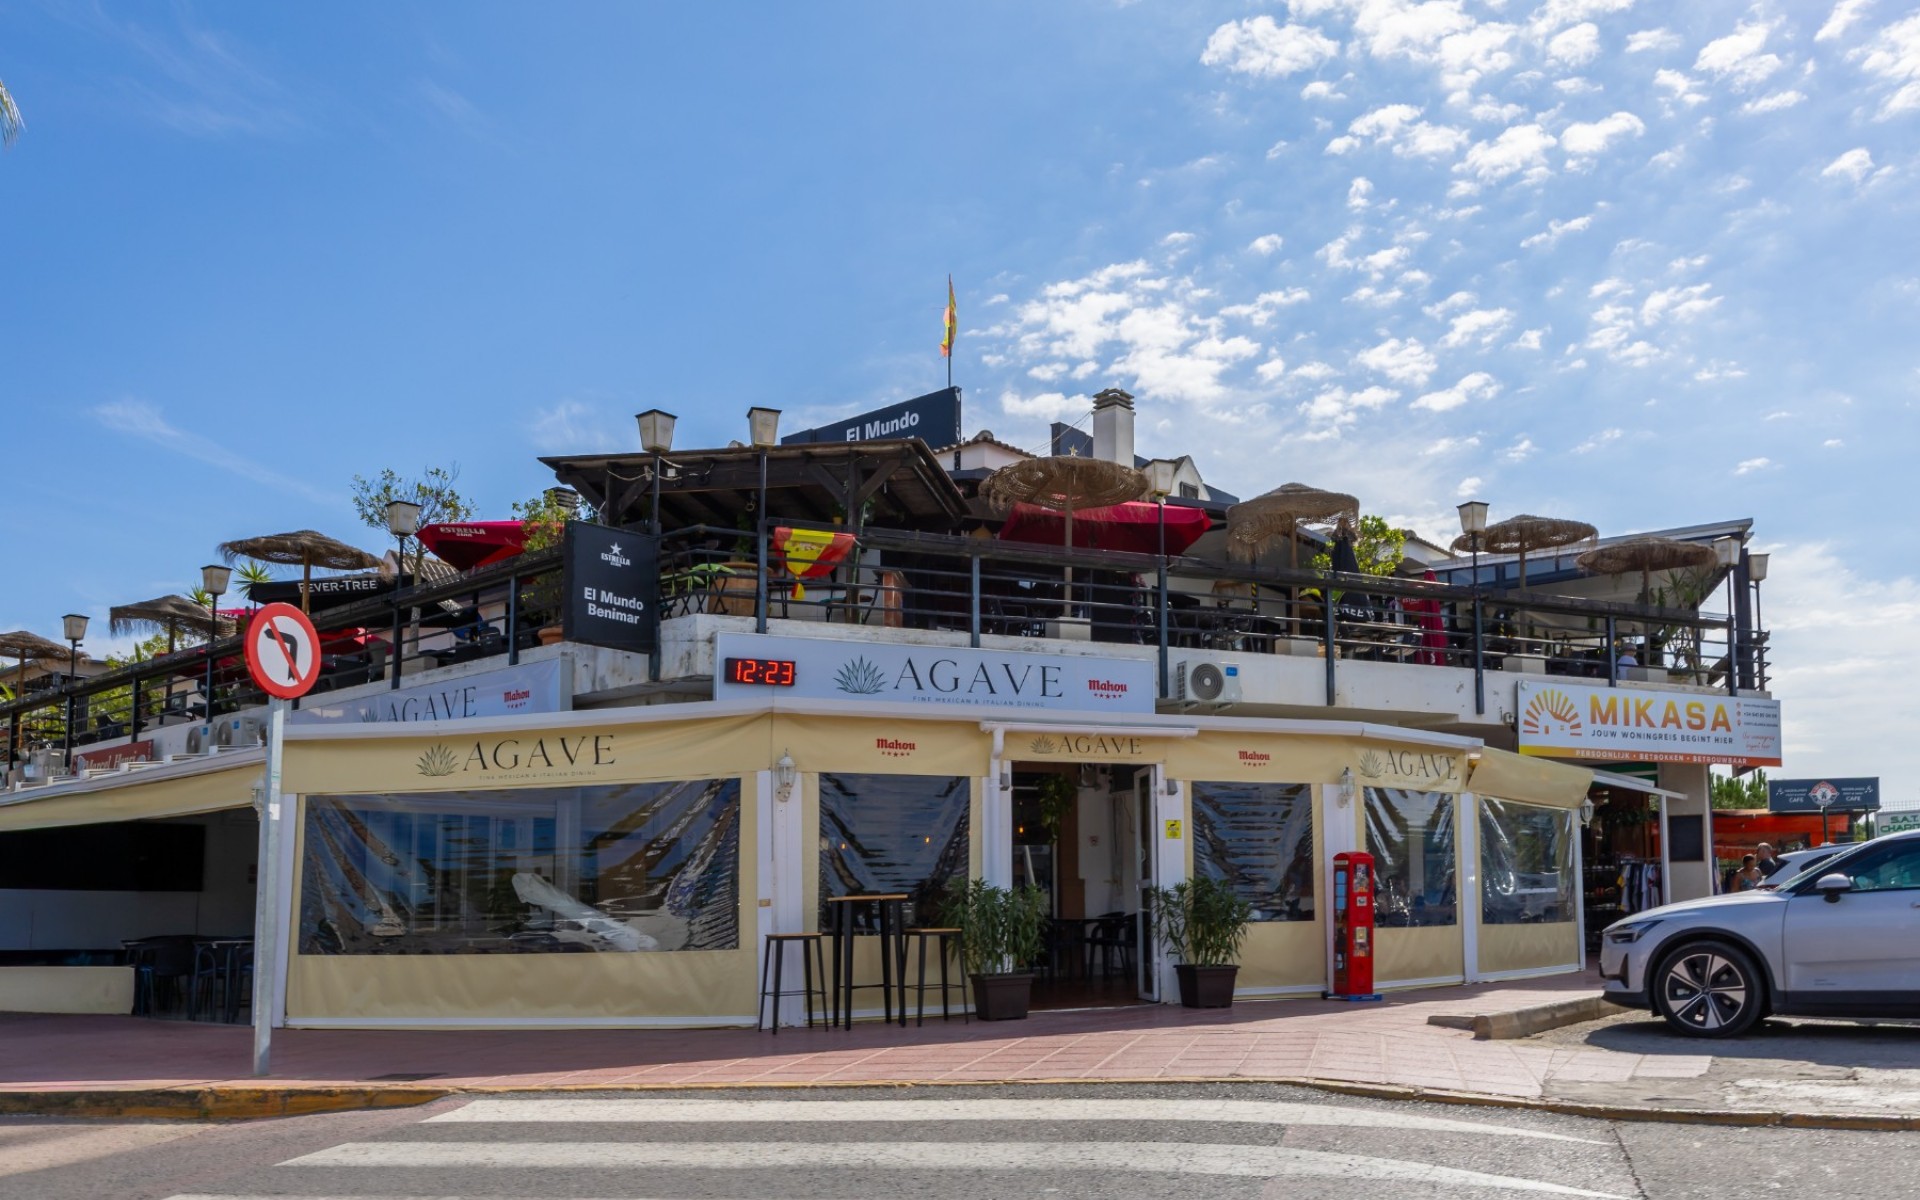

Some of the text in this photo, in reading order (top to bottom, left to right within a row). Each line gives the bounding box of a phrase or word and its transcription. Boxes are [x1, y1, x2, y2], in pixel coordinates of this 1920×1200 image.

[846, 411, 920, 441] El Mundo
[601, 552, 631, 566] ESTRELLA
[584, 587, 644, 611] El Mundo
[587, 603, 640, 624] Benimar
[736, 660, 793, 684] 12:23
[894, 657, 1063, 698] AGAVE
[503, 689, 530, 704] Mahou
[1088, 679, 1128, 693] Mahou
[387, 686, 477, 722] AGAVE
[1590, 694, 1732, 733] MIKASA
[876, 738, 916, 751] Mahou
[1057, 735, 1142, 754] AGAVE
[1591, 729, 1734, 744] JOUW WONINGREIS BEGINT HIER
[463, 734, 616, 771] AGAVE
[1238, 750, 1271, 761] Mahou
[1575, 749, 1748, 765] PERSOONLIJK BETROKKEN BETROUWBAAR
[1384, 749, 1458, 780] AGAVE
